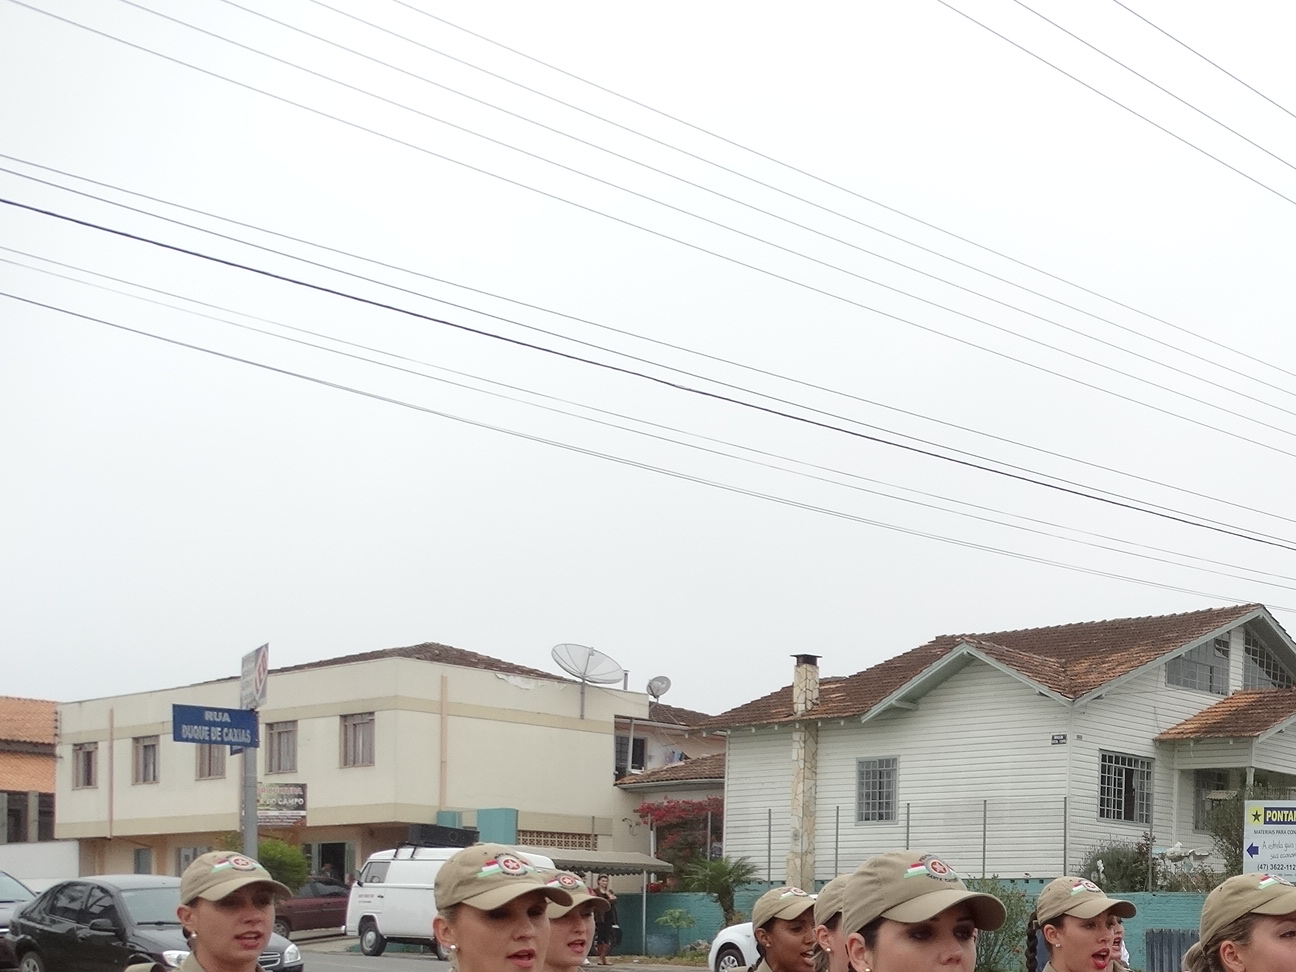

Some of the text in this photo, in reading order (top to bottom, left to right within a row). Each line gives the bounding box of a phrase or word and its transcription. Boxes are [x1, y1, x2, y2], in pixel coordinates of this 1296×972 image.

[204, 710, 231, 723] RUA
[181, 724, 251, 744] DUQUE DE CAXIAS
[1257, 863, 1269, 872] (47)
